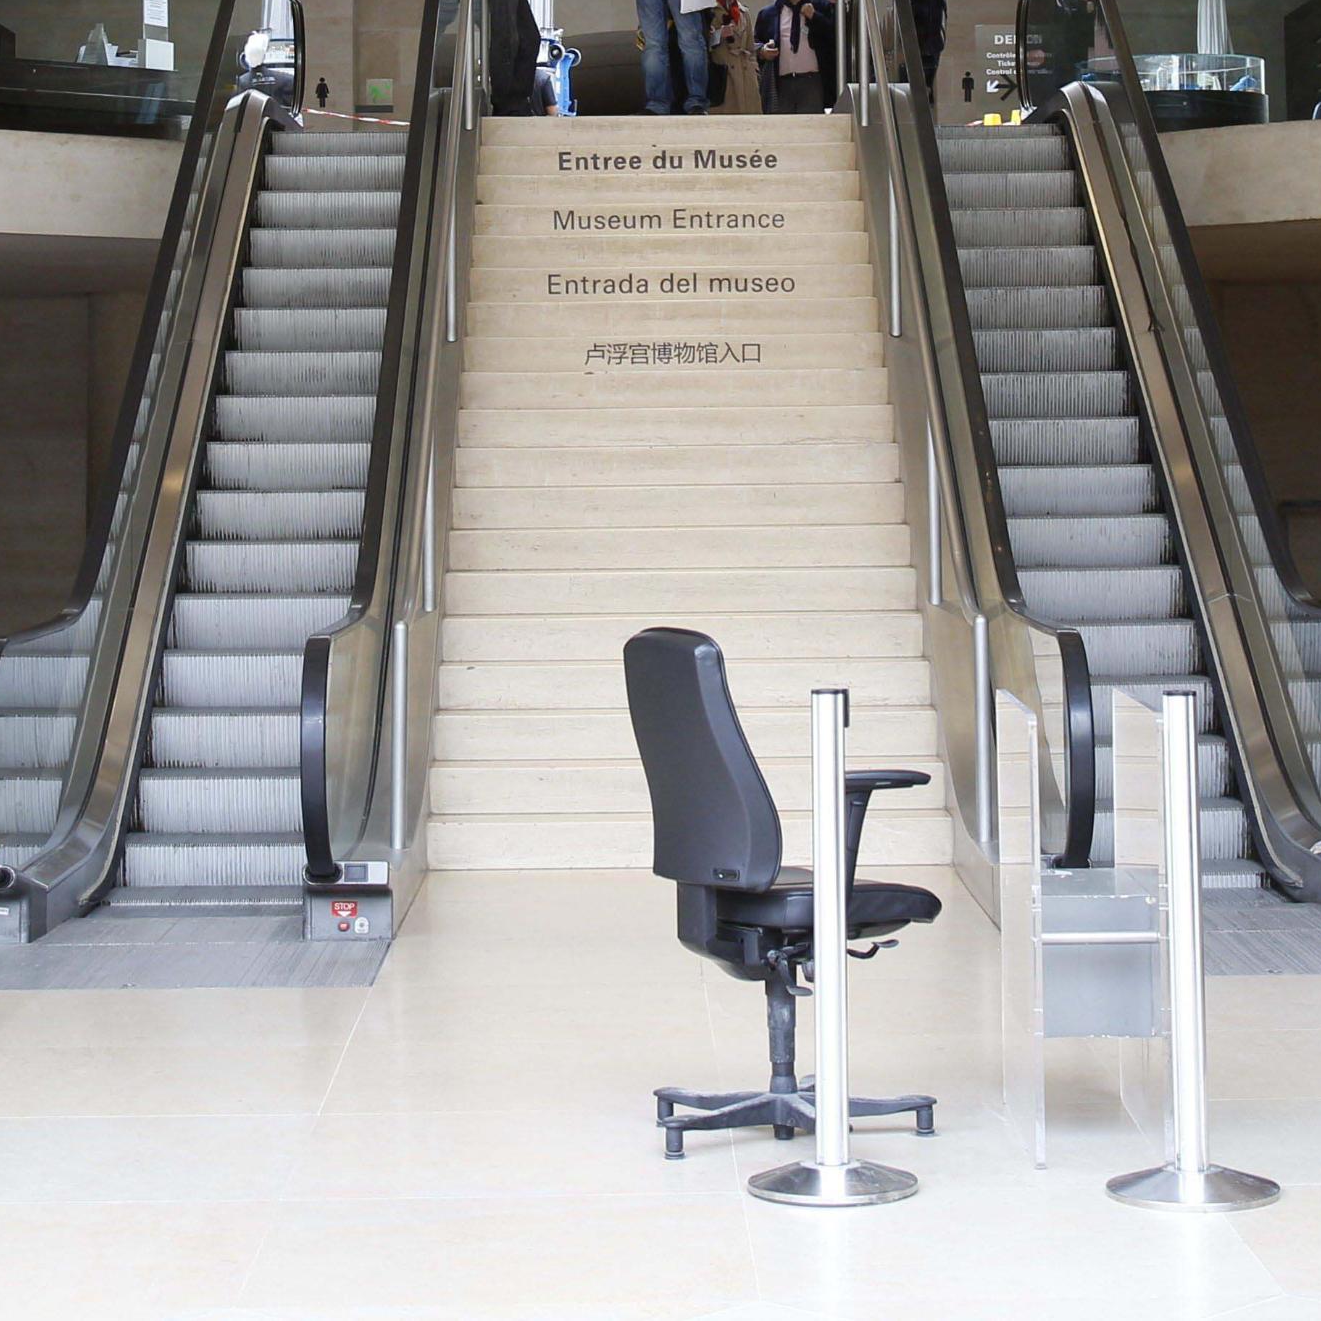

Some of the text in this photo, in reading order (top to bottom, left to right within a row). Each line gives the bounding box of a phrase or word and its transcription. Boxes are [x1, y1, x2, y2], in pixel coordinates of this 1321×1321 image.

[558, 148, 778, 171] Entree du Musée
[553, 208, 785, 230] Museum Entrance
[547, 272, 796, 295] Entrada del museo
[584, 341, 761, 366] 卢浮宫博物馆入口
[334, 902, 355, 911] STOP
